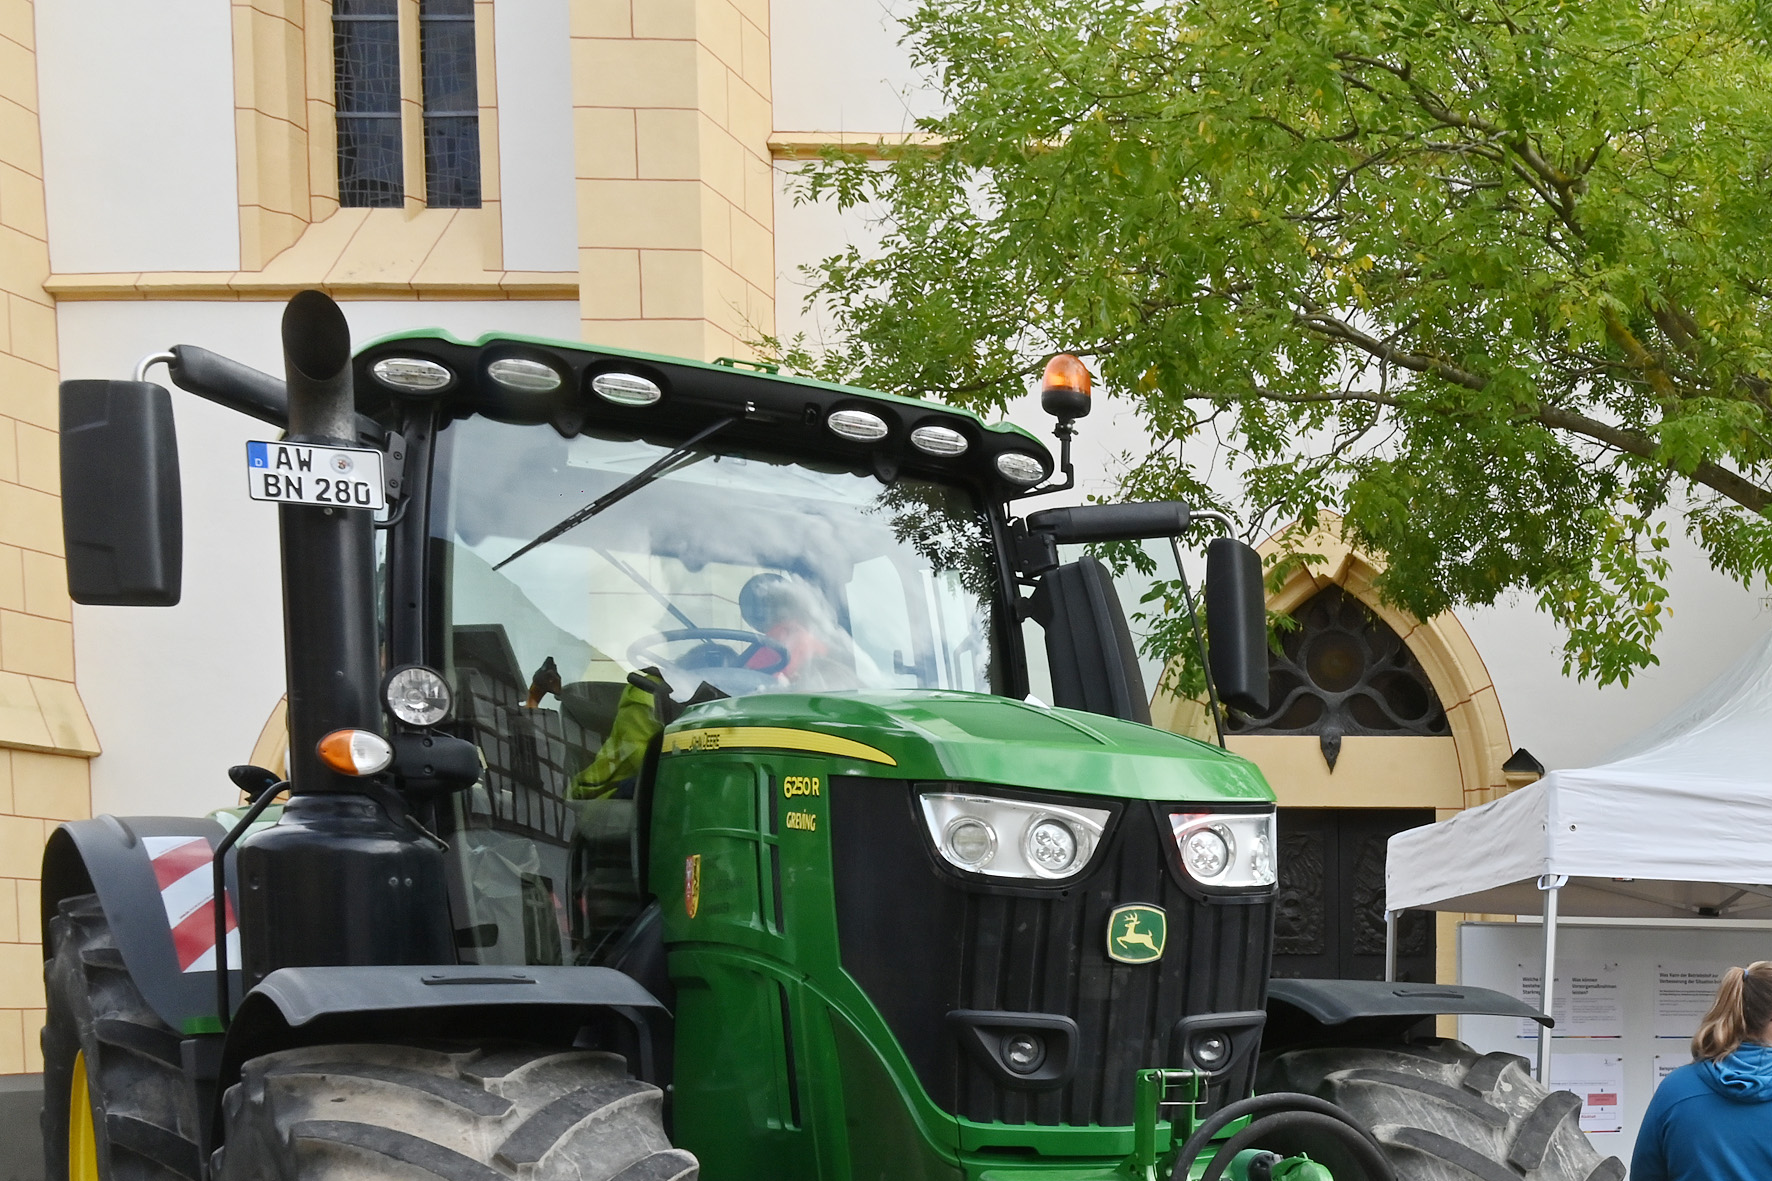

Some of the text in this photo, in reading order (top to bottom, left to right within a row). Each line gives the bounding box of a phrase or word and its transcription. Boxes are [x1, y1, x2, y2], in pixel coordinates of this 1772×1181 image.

[254, 458, 263, 467] D
[276, 447, 313, 472] AW
[264, 474, 371, 505] BN 280
[784, 776, 820, 799] 6250 R
